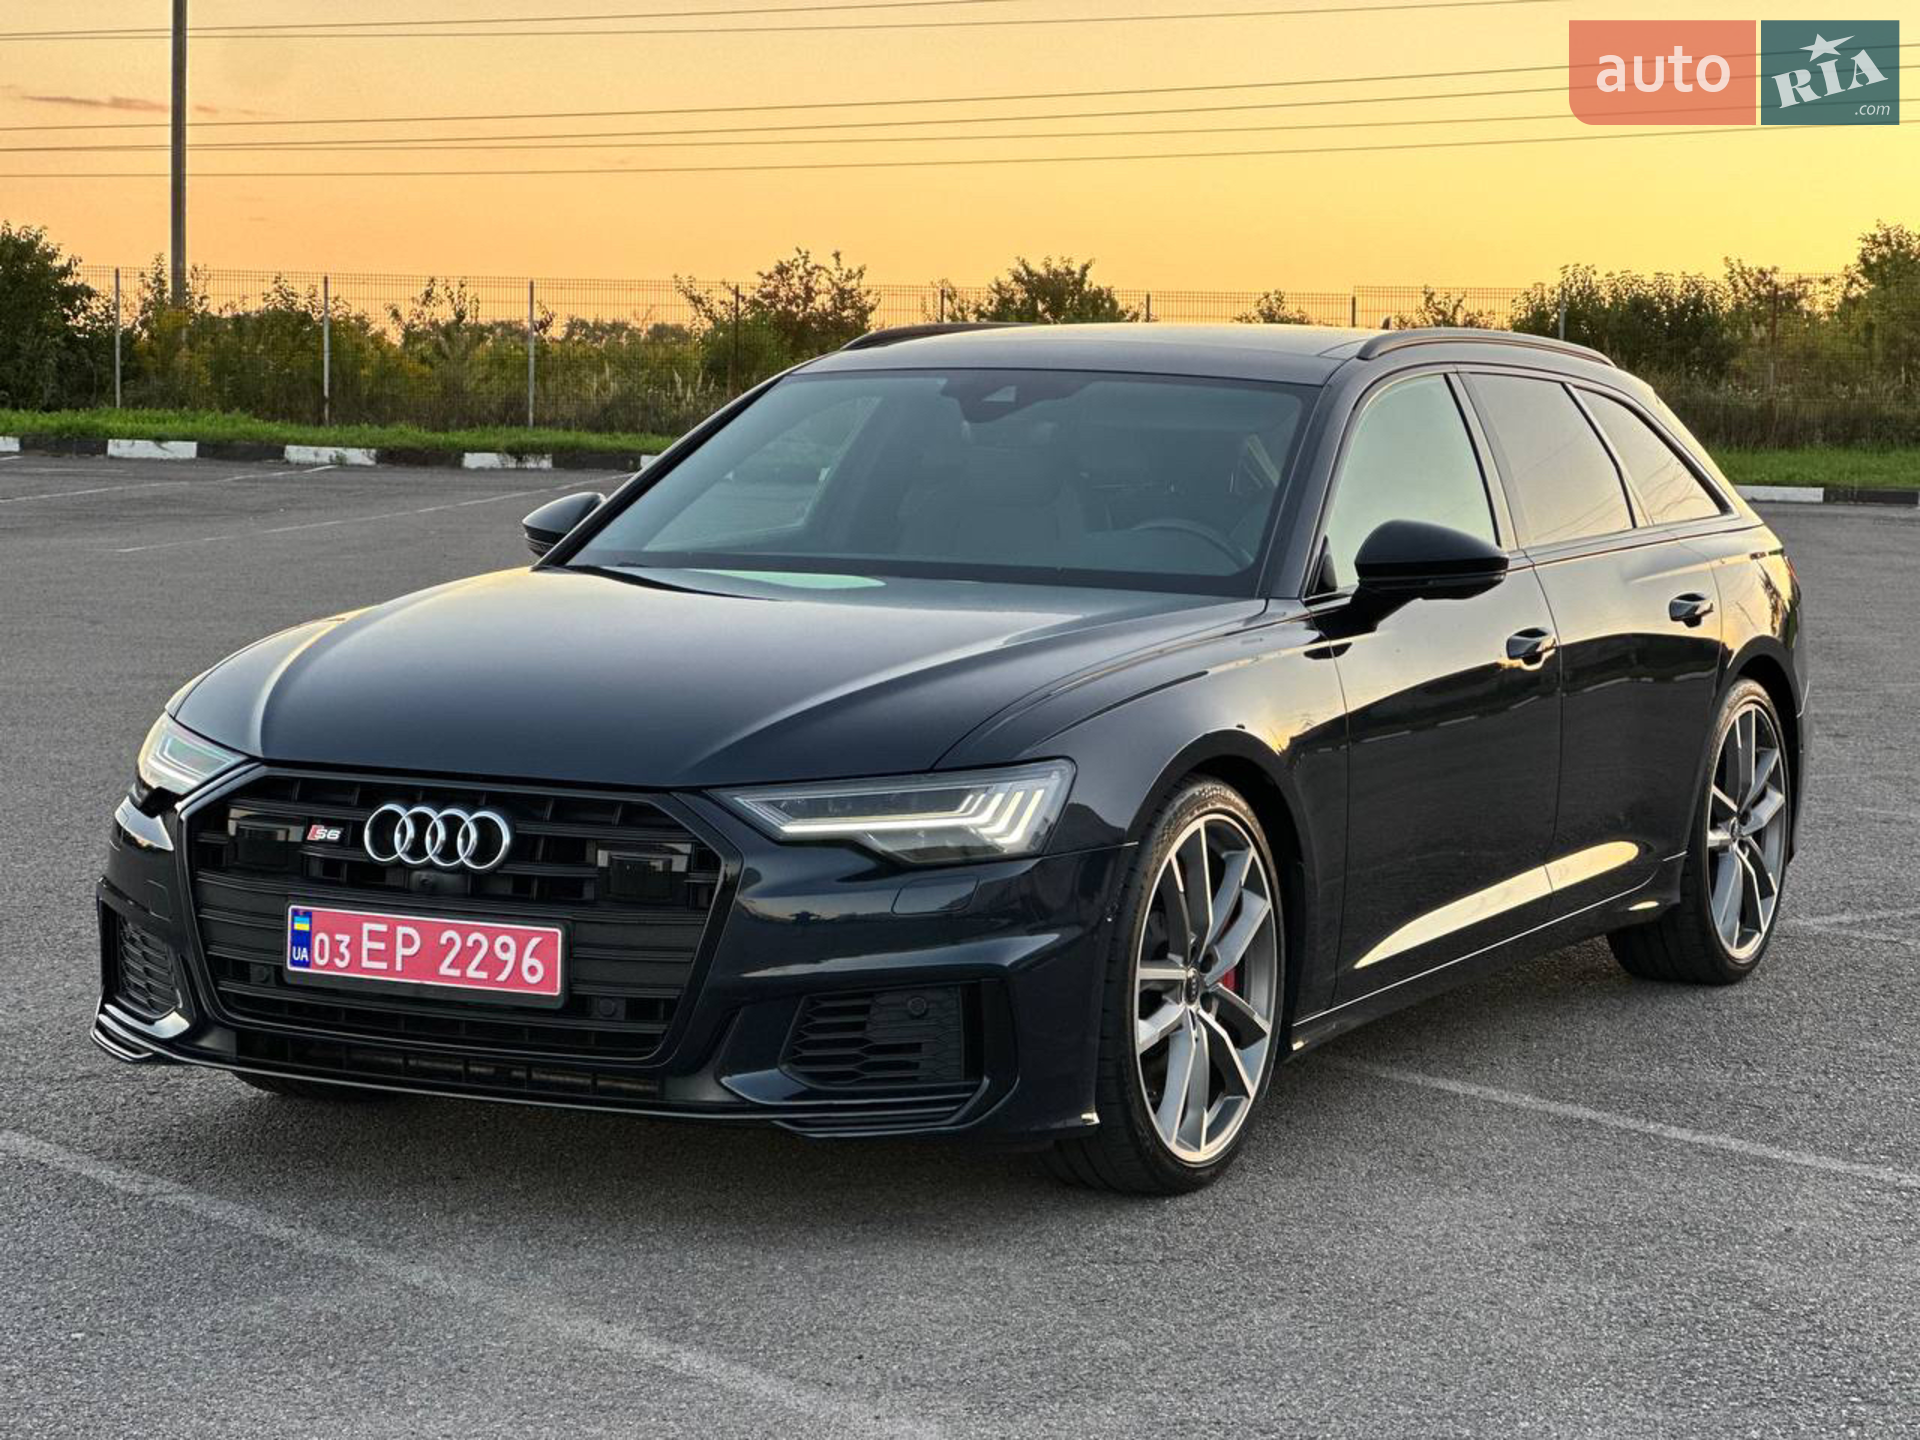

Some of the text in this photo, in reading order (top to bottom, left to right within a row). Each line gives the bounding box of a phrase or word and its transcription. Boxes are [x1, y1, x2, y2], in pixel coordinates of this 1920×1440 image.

[312, 827, 342, 840] S6
[292, 946, 309, 962] UA
[313, 922, 544, 984] 03 EP 2296
